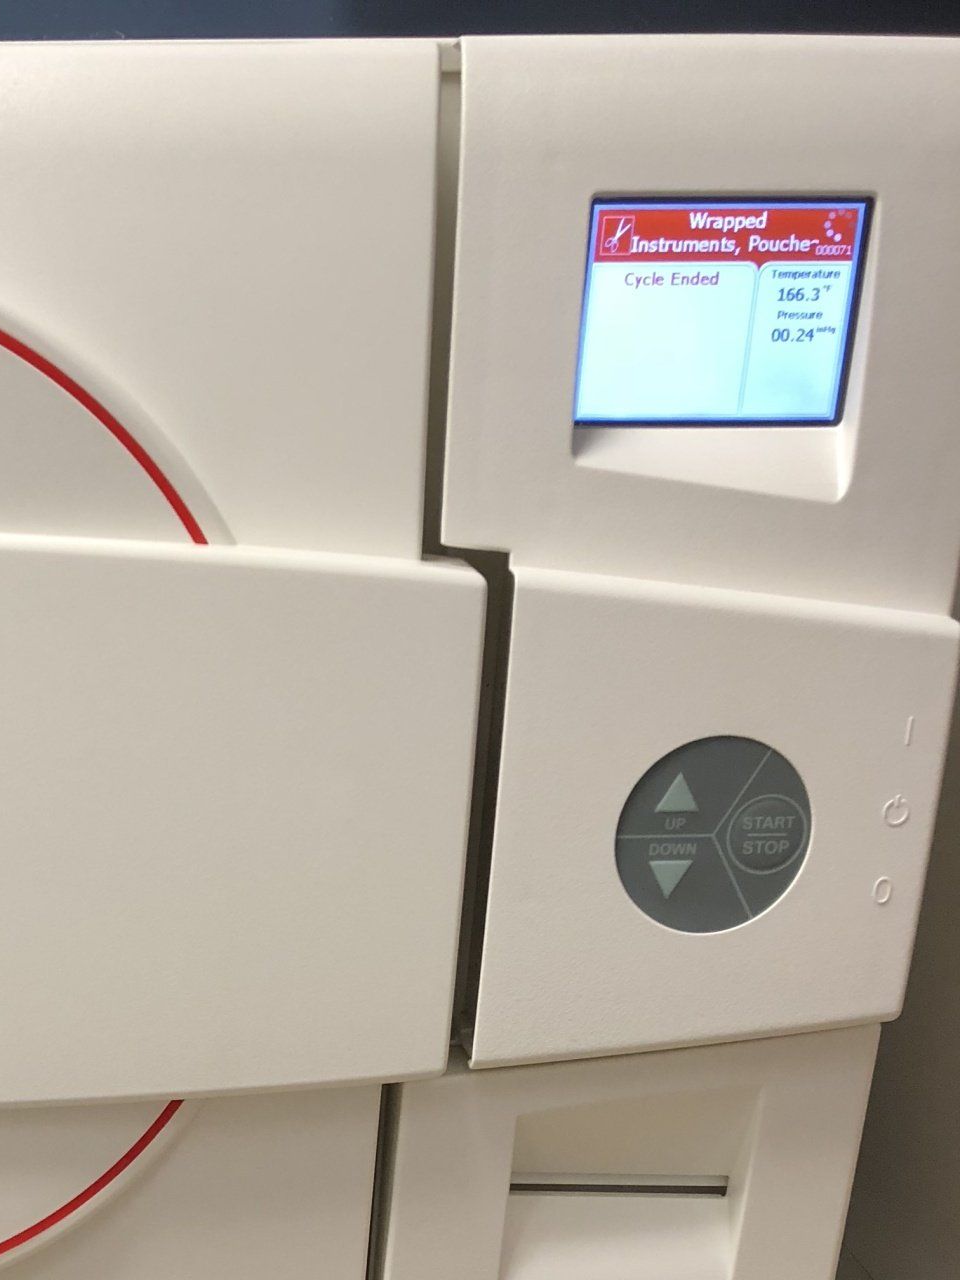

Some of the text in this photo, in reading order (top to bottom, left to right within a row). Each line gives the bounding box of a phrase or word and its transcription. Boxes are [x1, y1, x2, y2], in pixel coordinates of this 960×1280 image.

[689, 211, 767, 231] Wrapped
[630, 235, 741, 256] Instruments,
[624, 271, 720, 289] Cycle Ended
[772, 269, 841, 280] Temperature
[777, 287, 821, 301] 166.3
[777, 310, 823, 320] Pressure
[771, 328, 815, 342] 00.24
[664, 817, 687, 831] UP
[742, 815, 795, 830] START
[649, 842, 698, 856] DOWN
[742, 840, 790, 855] STOP
